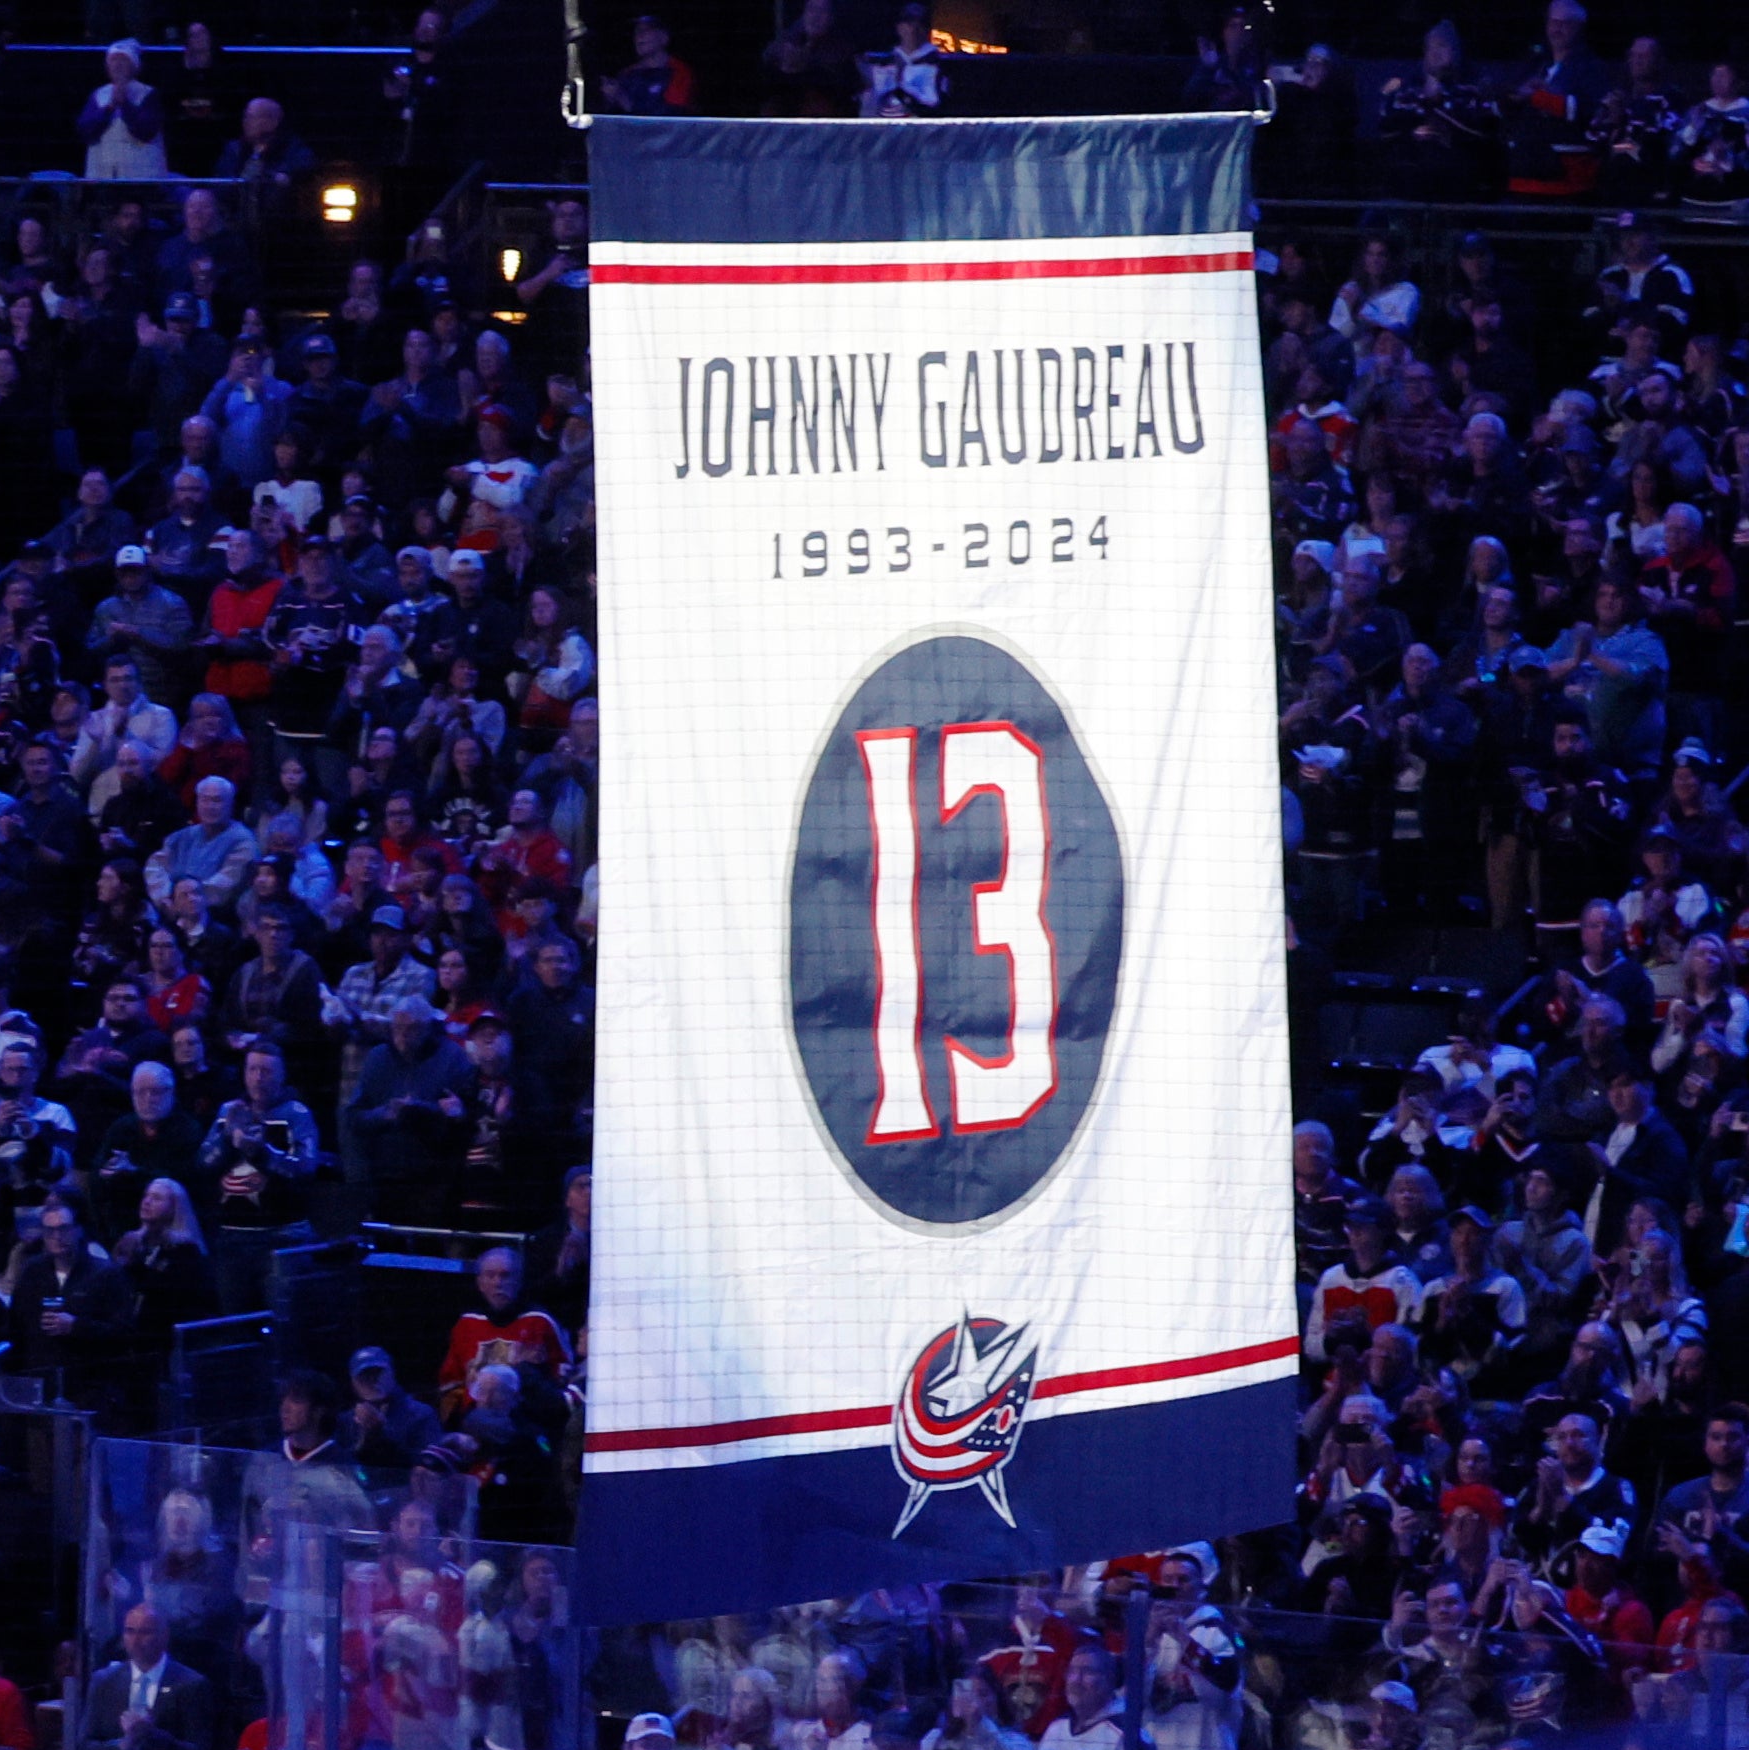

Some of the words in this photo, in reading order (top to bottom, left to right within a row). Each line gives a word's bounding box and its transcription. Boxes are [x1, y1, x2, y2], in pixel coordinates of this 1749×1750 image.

[674, 353, 892, 479] JOHNNY
[917, 341, 1205, 469] GAUDREAU
[771, 515, 1111, 580] 1993-2024
[854, 721, 1059, 1145] 13
